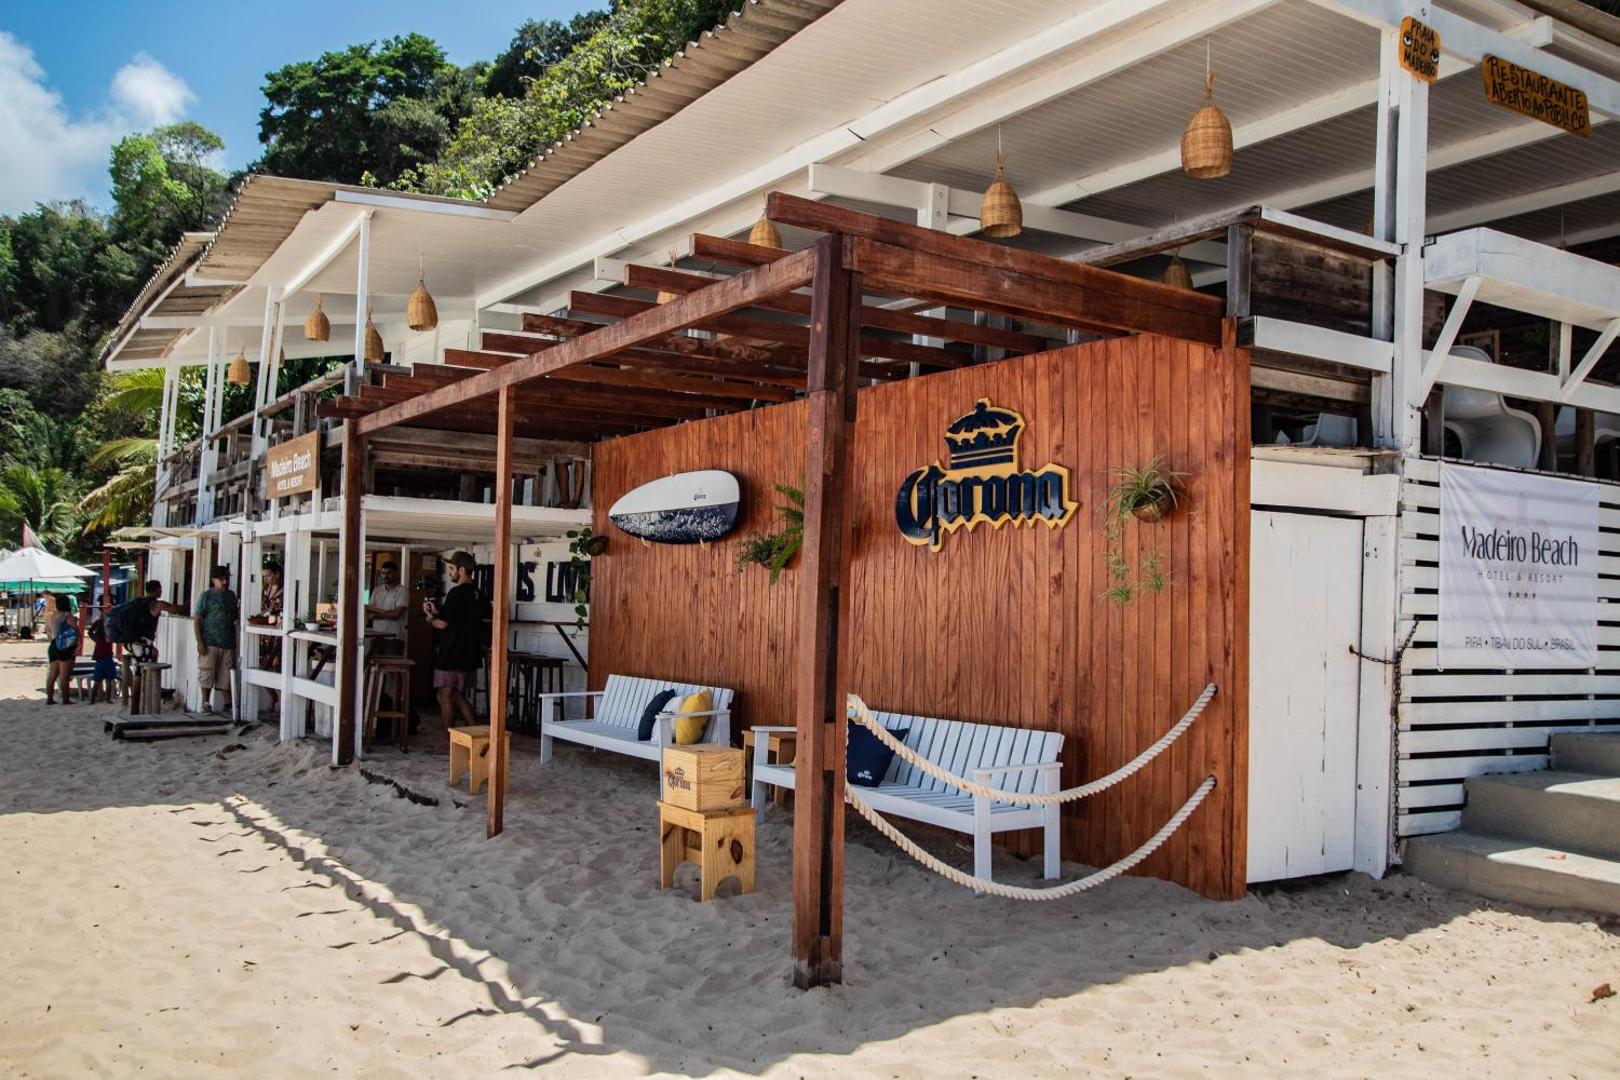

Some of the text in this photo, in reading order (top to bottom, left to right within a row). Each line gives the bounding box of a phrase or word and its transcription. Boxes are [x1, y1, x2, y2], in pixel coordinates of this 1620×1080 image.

[1410, 17, 1434, 48] PRAIA
[1412, 39, 1427, 56] DO
[1487, 56, 1585, 110] RESTAURANTE
[1491, 79, 1532, 111] ABERTO
[895, 465, 1067, 546] Corona
[1461, 525, 1578, 567] Madeiro Beach
[1478, 570, 1510, 582] HOTEL
[1527, 572, 1563, 583] RESORT
[1512, 638, 1526, 650] DO
[1526, 638, 1543, 650] SUL
[1550, 638, 1576, 651] BRASIL
